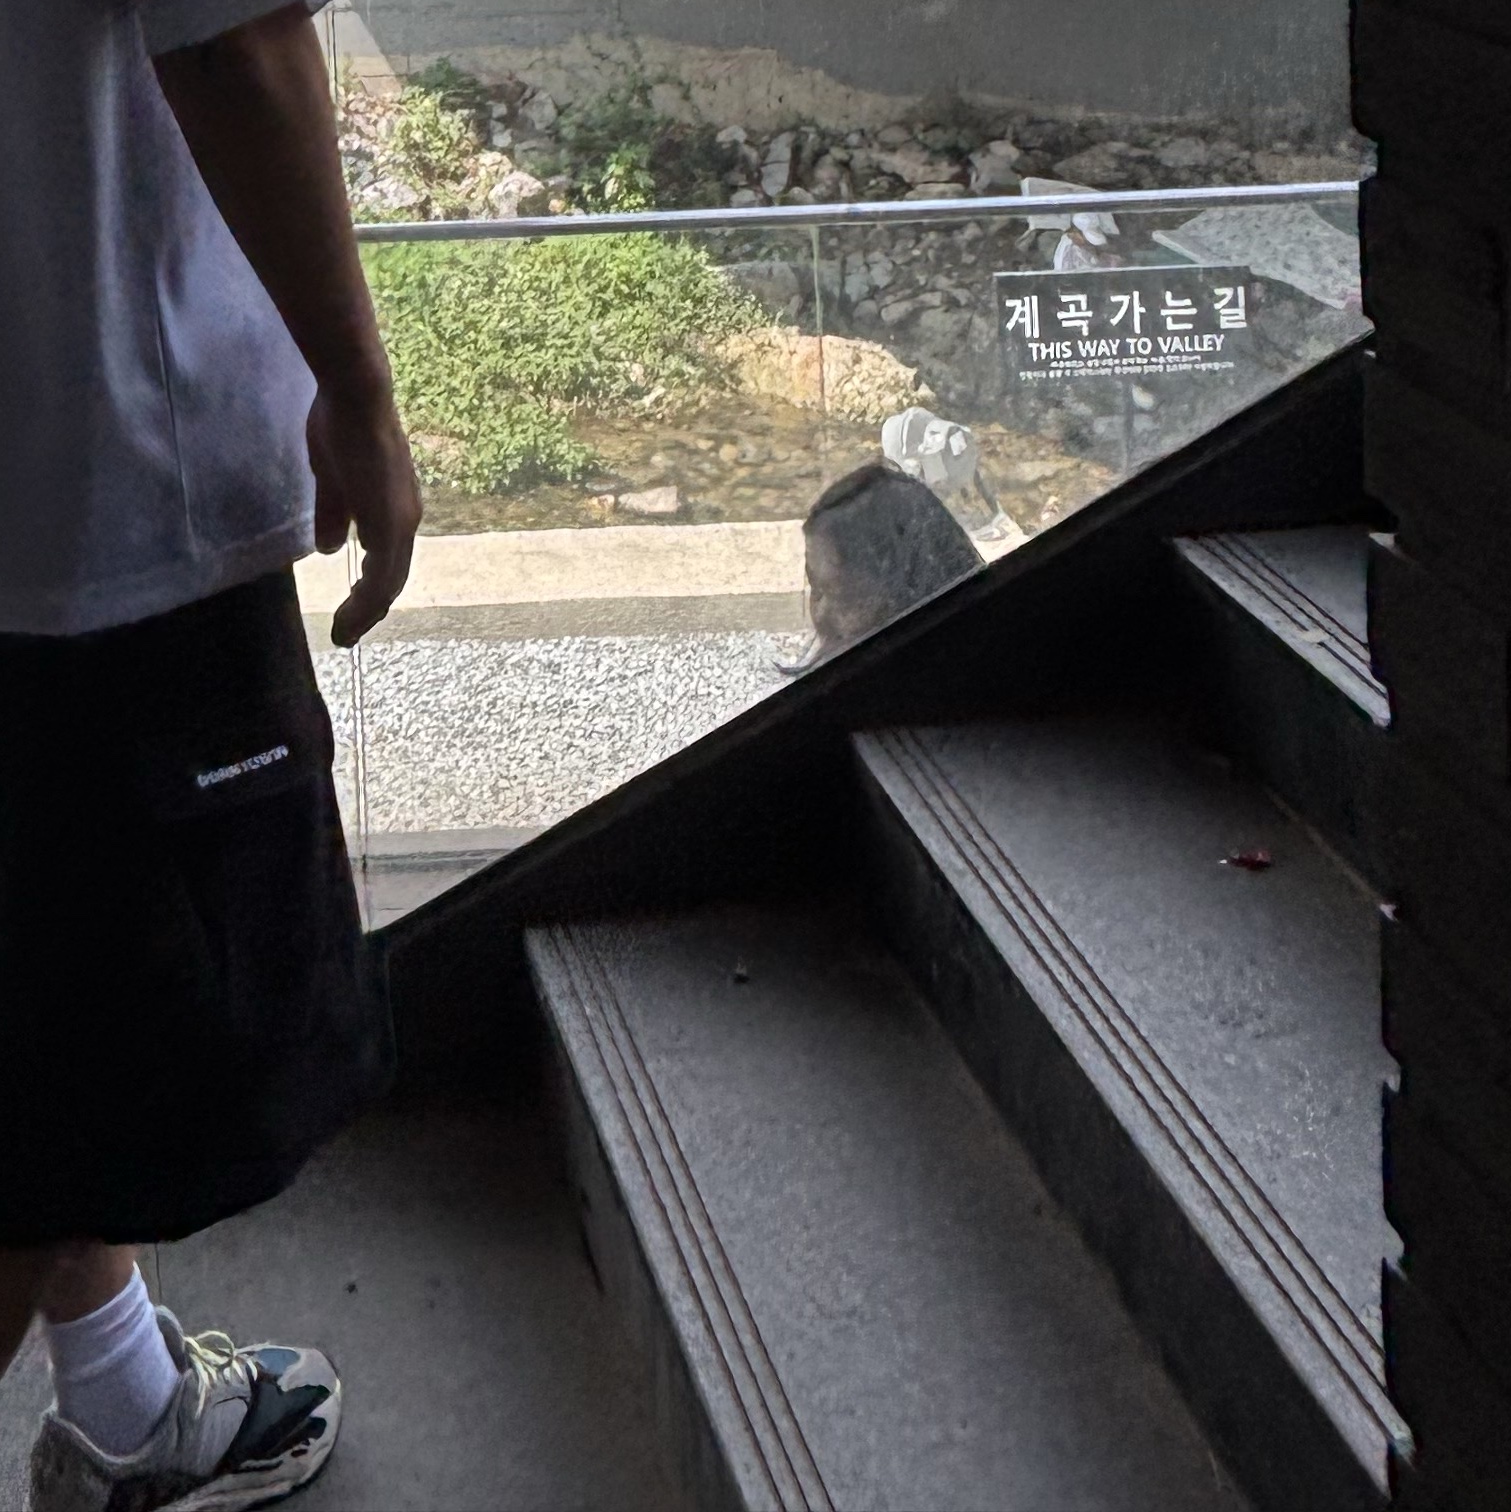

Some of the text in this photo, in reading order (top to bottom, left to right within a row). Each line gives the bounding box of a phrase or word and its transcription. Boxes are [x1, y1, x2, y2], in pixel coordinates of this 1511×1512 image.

[1027, 340, 1072, 362] THIS
[1078, 338, 1121, 358] WAY
[1126, 337, 1152, 357] TO
[1157, 334, 1225, 355] VALLEY
